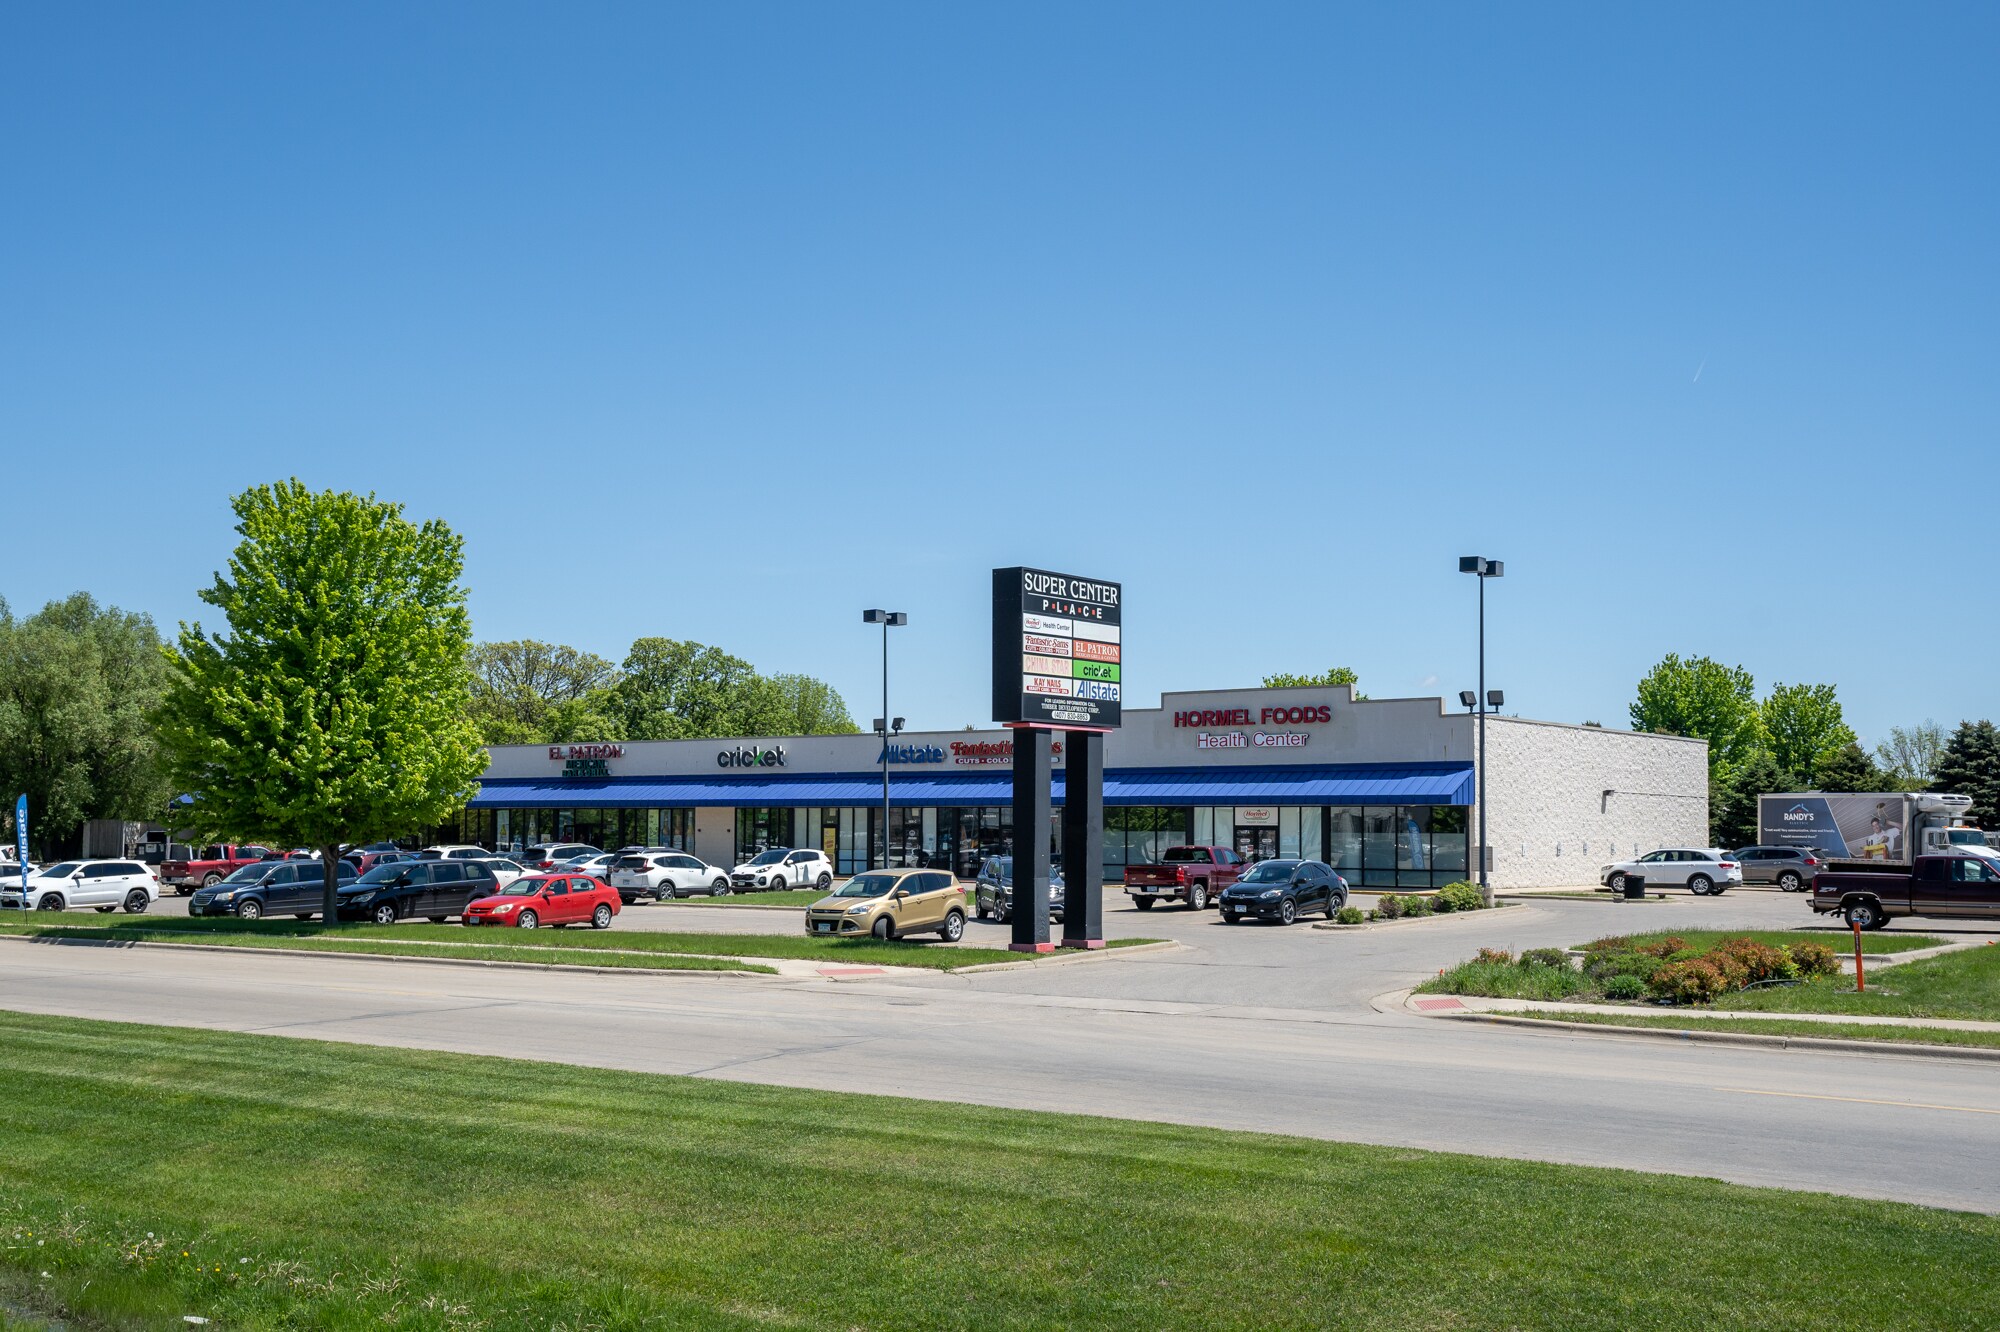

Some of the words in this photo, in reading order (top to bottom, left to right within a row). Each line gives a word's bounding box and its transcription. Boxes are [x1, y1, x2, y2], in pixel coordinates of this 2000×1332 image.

[1024, 572, 1067, 597] SUPER
[1070, 580, 1118, 605] CENTER
[1042, 621, 1056, 629] Health
[1025, 635, 1052, 646] Fantastic
[1052, 639, 1069, 649] Sams
[1075, 641, 1086, 653] EL
[1087, 643, 1118, 657] PATRON
[1083, 664, 1112, 678] cricket
[1046, 679, 1061, 688] NAILS
[1076, 680, 1118, 701] Allstate
[1058, 704, 1088, 713] DEVELOPMENT
[1174, 708, 1256, 728] HORMEL
[1261, 705, 1331, 725] FOODS
[1196, 732, 1248, 748] Health
[1252, 730, 1309, 748] Center
[548, 746, 566, 760] EL
[717, 745, 785, 768] cricket
[877, 744, 944, 764] Allstate
[565, 759, 607, 769] MEXICAN
[19, 809, 27, 863] Allstate
